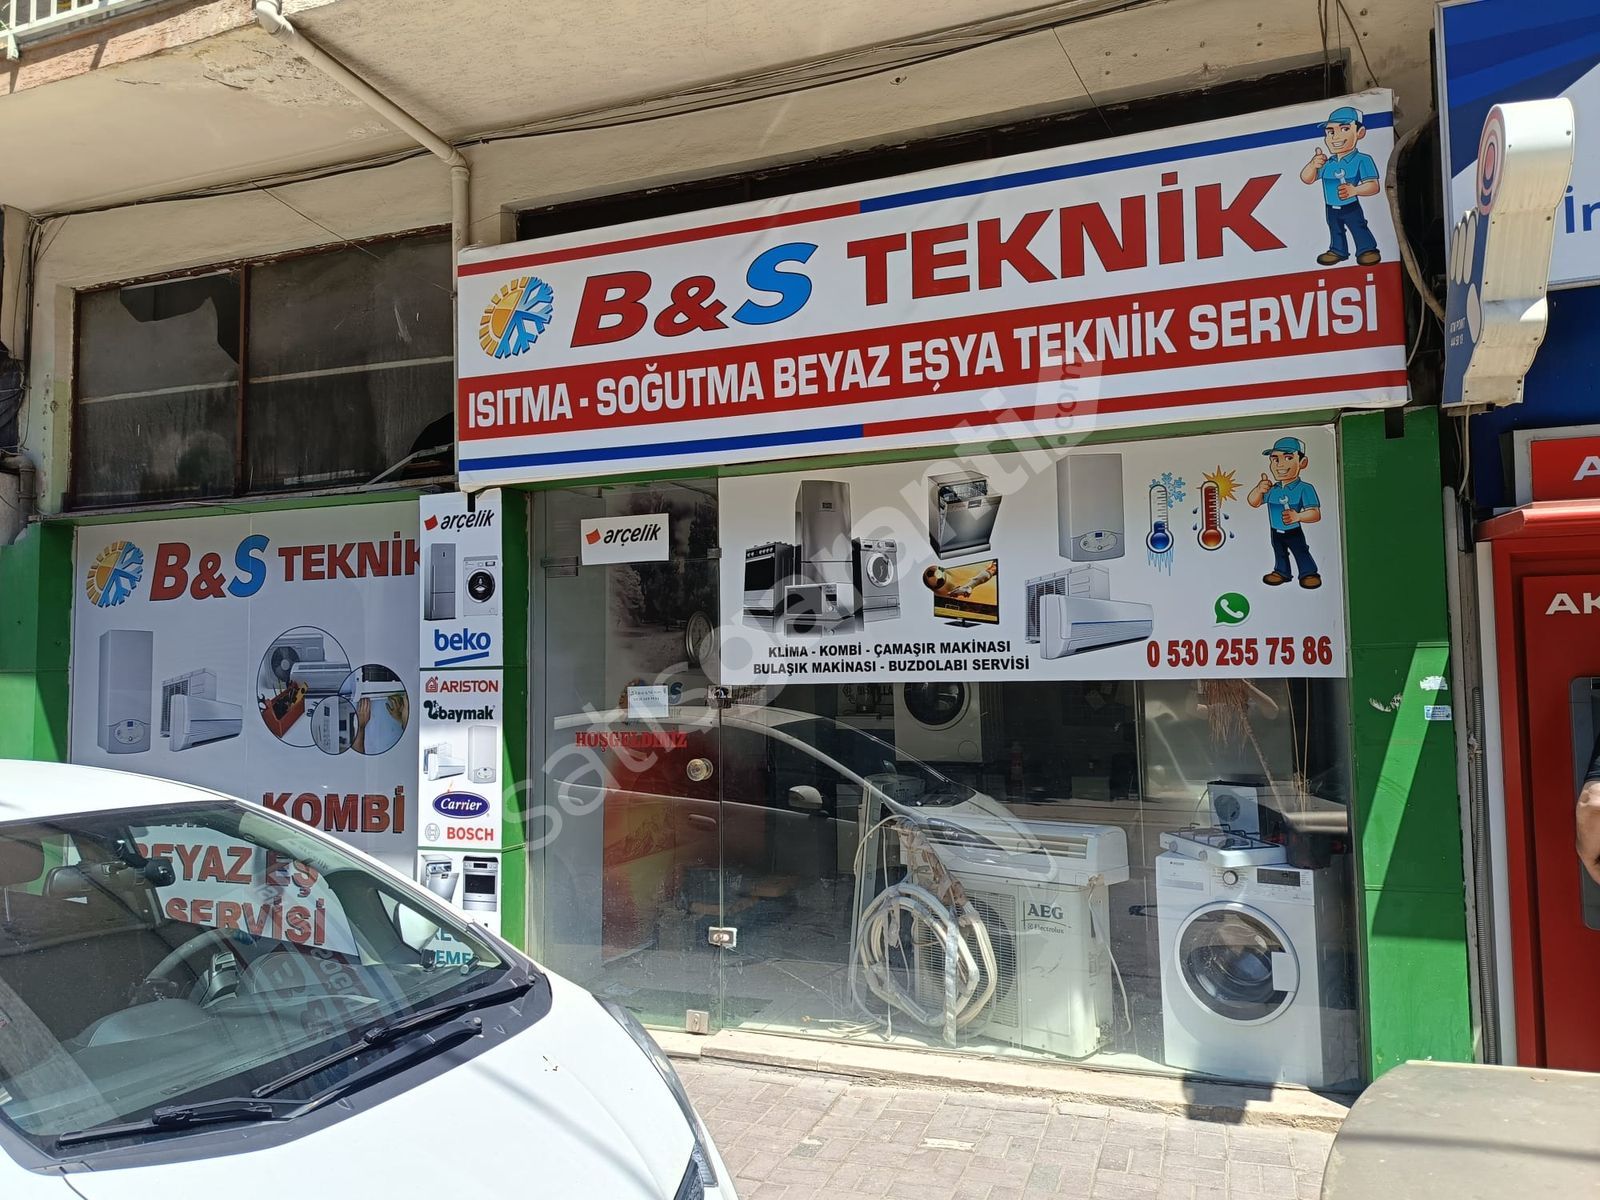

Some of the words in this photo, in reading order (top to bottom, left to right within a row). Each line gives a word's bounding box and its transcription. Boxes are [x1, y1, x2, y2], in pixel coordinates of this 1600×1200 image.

[570, 242, 818, 348] B&S
[847, 171, 1288, 307] TEKNİK
[468, 382, 573, 428] ISITMA
[596, 362, 764, 416] SOĞUTMA
[774, 345, 891, 399] BEYAZ
[901, 328, 1003, 392] EŞYA
[1013, 302, 1177, 369] TEKNİK
[1189, 273, 1378, 350] SERVİSİ
[440, 509, 495, 533] arçelik
[603, 523, 661, 546] arçelik
[149, 534, 270, 601] B&S
[434, 628, 491, 651] beko
[768, 644, 808, 658] KLİMA
[819, 642, 862, 657] KOMBİ
[874, 642, 936, 659] ÇAMAŞIR
[940, 639, 1011, 654] MAKİNASI
[1147, 640, 1161, 668] 0
[1167, 639, 1208, 667] 530
[1216, 637, 1259, 666] 255
[1265, 636, 1295, 665] 75
[1302, 635, 1333, 665] 86
[753, 661, 808, 677] BULAŞIK
[811, 659, 876, 674] MAKİNASI
[888, 658, 968, 672] BUZDOLABI
[972, 655, 1030, 671] SERVİSİ
[440, 680, 498, 693] ARISTON
[438, 705, 494, 722] baymak
[440, 798, 482, 811] Carrier
[447, 827, 494, 841] BOSCH
[1027, 903, 1064, 920] AEG
